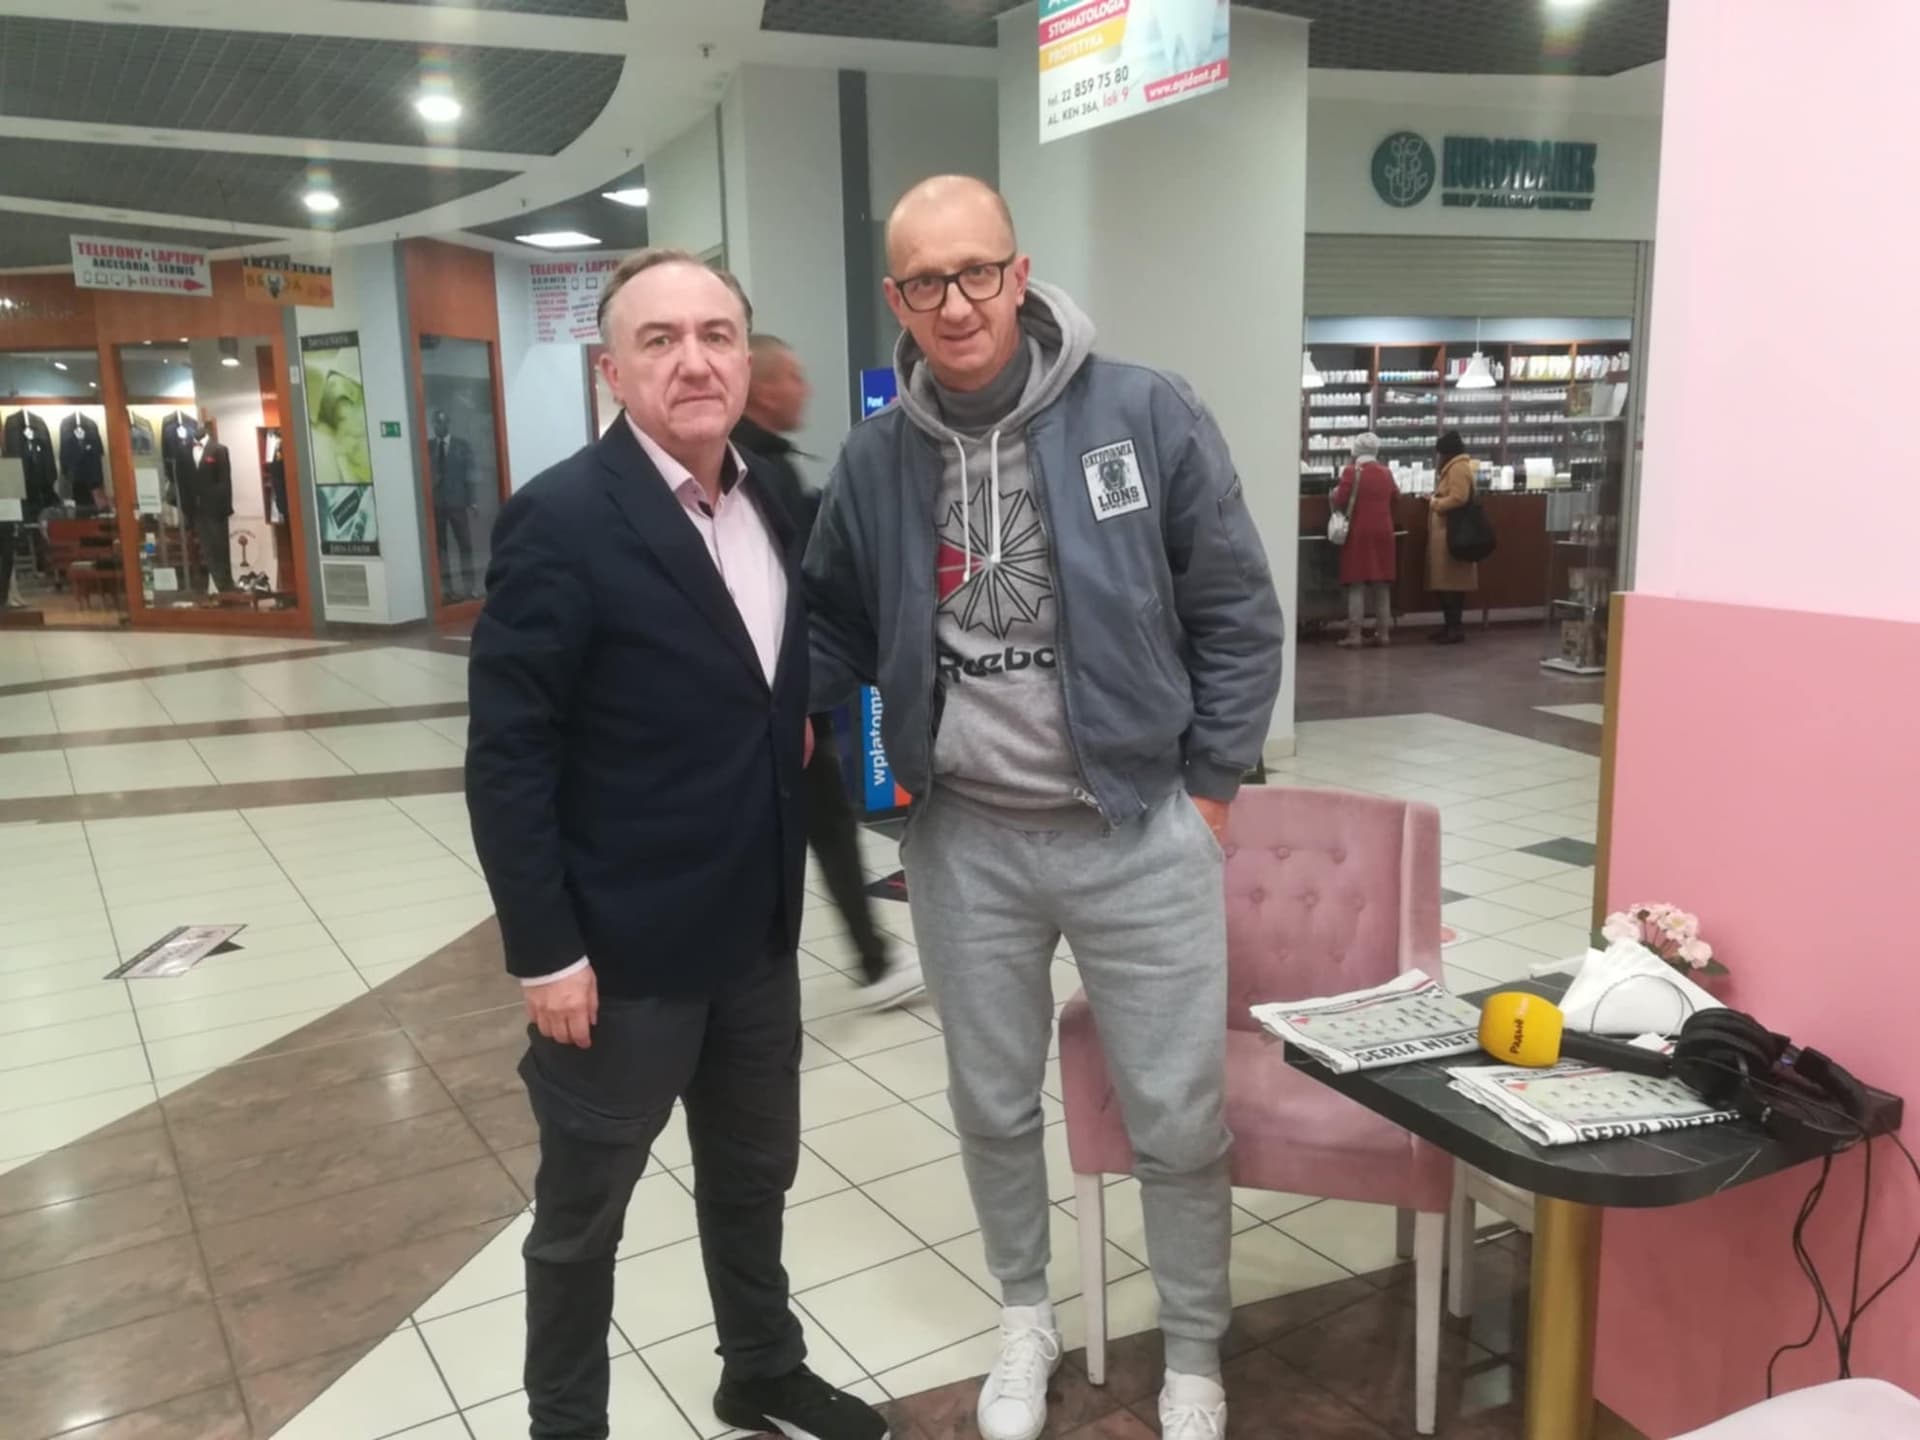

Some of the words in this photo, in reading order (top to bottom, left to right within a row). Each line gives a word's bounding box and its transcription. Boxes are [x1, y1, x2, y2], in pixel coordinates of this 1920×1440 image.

[1047, 0, 1126, 39] STOMATOLOGIA
[1062, 88, 1072, 102] 22
[1074, 77, 1095, 98] 859
[1098, 71, 1111, 88] 75
[1114, 65, 1129, 84] 80
[1062, 106, 1080, 120] KEN
[1122, 86, 1129, 100] 9
[77, 241, 142, 259] TELEFONY
[151, 249, 205, 266] LAPTOPY
[93, 257, 150, 272] AKCESORIA
[530, 262, 577, 275] TELEFONY
[1098, 486, 1139, 508] LIONS
[1354, 1043, 1424, 1063] SERIA
